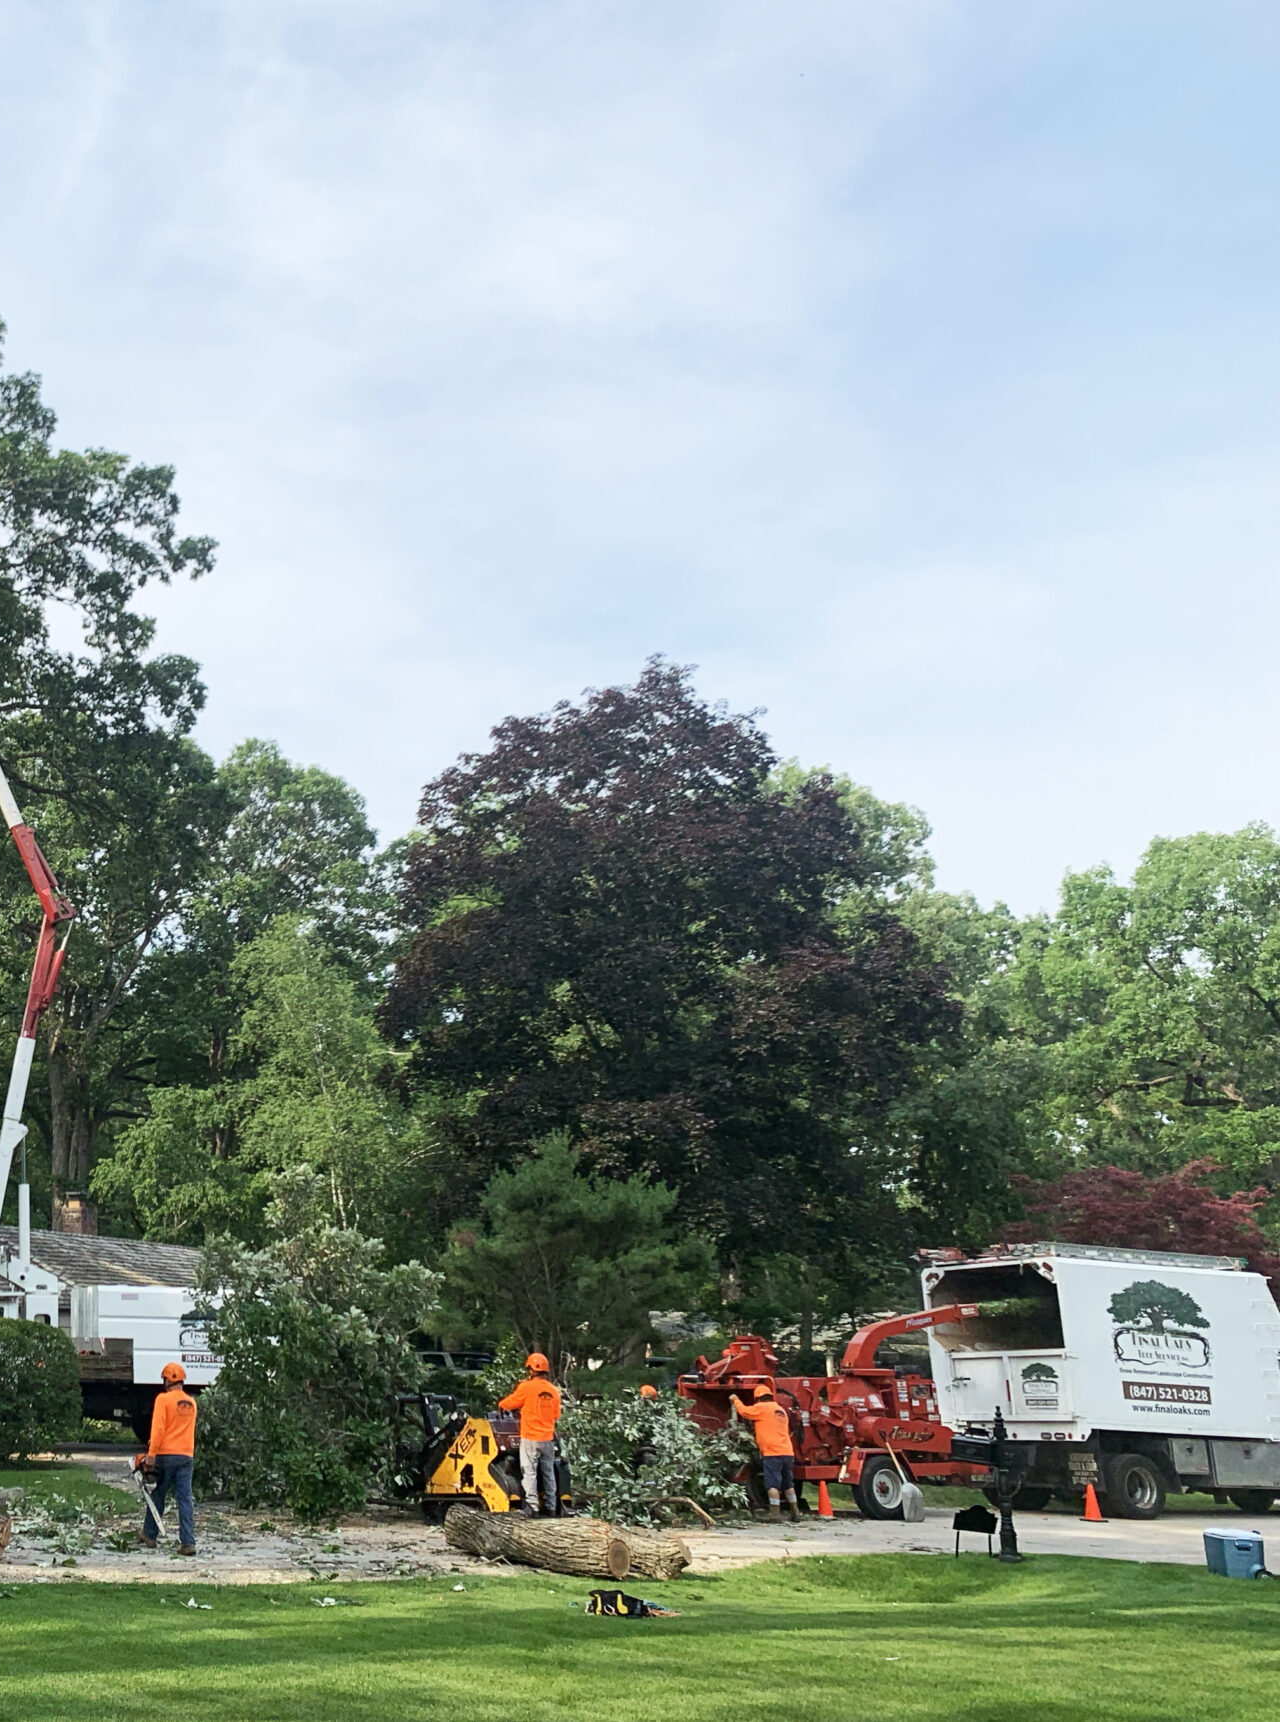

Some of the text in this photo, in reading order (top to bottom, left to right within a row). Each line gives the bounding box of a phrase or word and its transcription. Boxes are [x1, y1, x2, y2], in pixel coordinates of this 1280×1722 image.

[1129, 1385, 1208, 1402] (847) 521-0328
[1132, 1403, 1210, 1416] www.finaloaks.com
